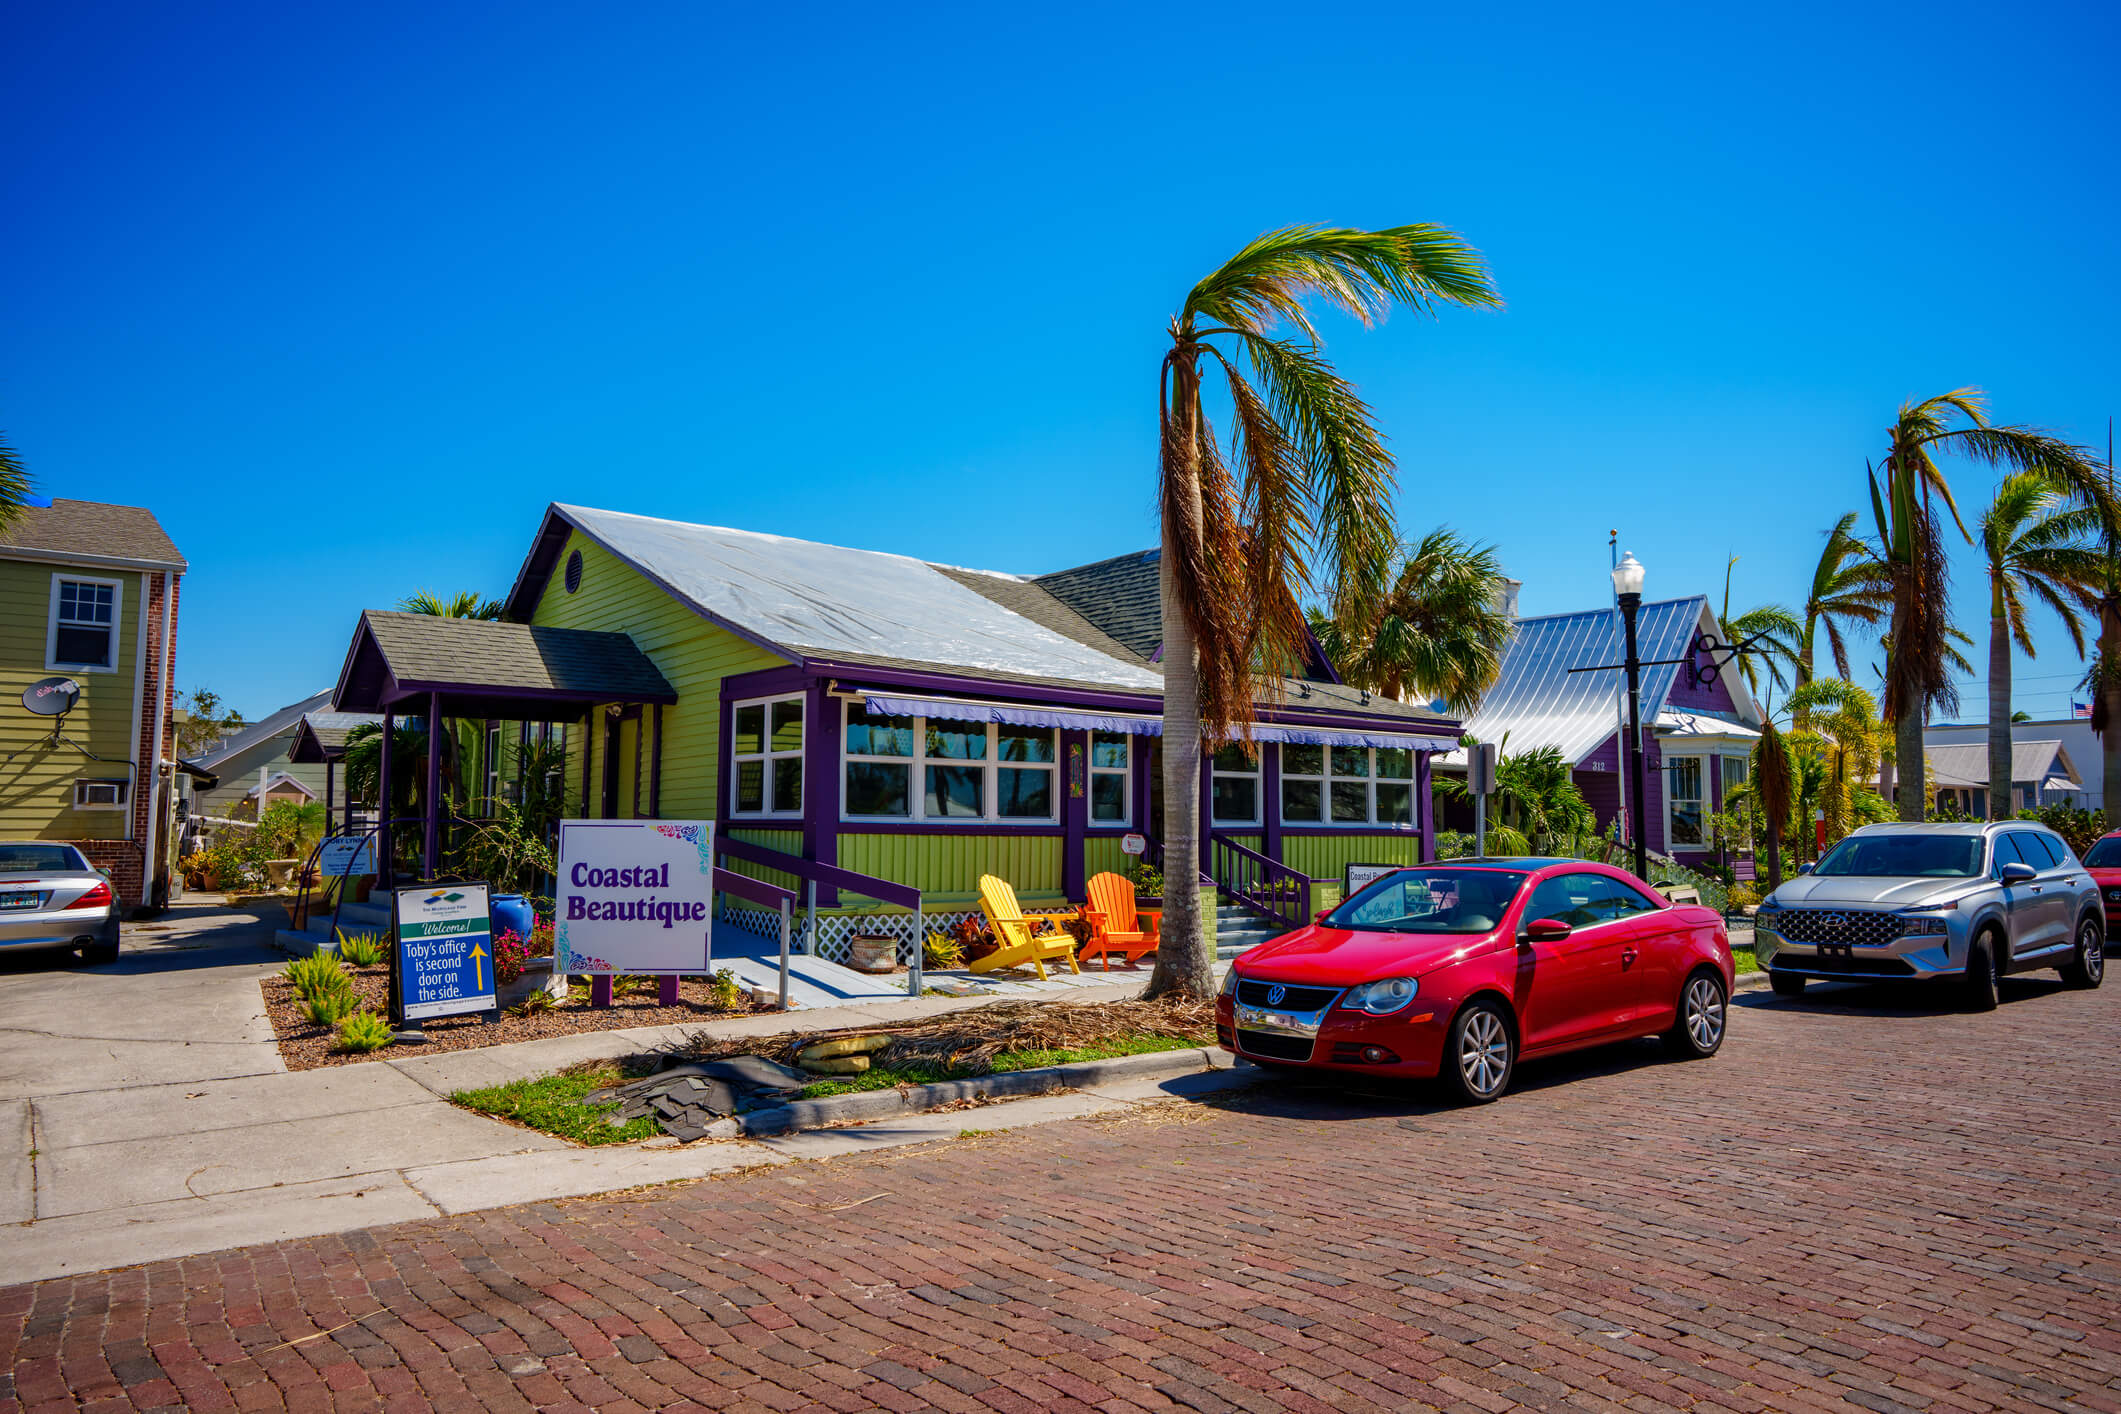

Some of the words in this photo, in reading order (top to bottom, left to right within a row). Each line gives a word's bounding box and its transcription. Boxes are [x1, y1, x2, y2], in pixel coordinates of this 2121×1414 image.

[1592, 761, 1605, 771] 312
[571, 862, 669, 888] Coastal
[1350, 872, 1372, 881] Coastal
[566, 896, 706, 929] Beautique
[421, 919, 471, 935] Welcome!
[405, 942, 437, 960] Toby's
[438, 940, 467, 954] office
[415, 958, 424, 972] is
[426, 954, 462, 971] second
[418, 973, 443, 986] door
[444, 972, 458, 983] on
[418, 986, 437, 1001] the
[438, 984, 463, 998] side.
